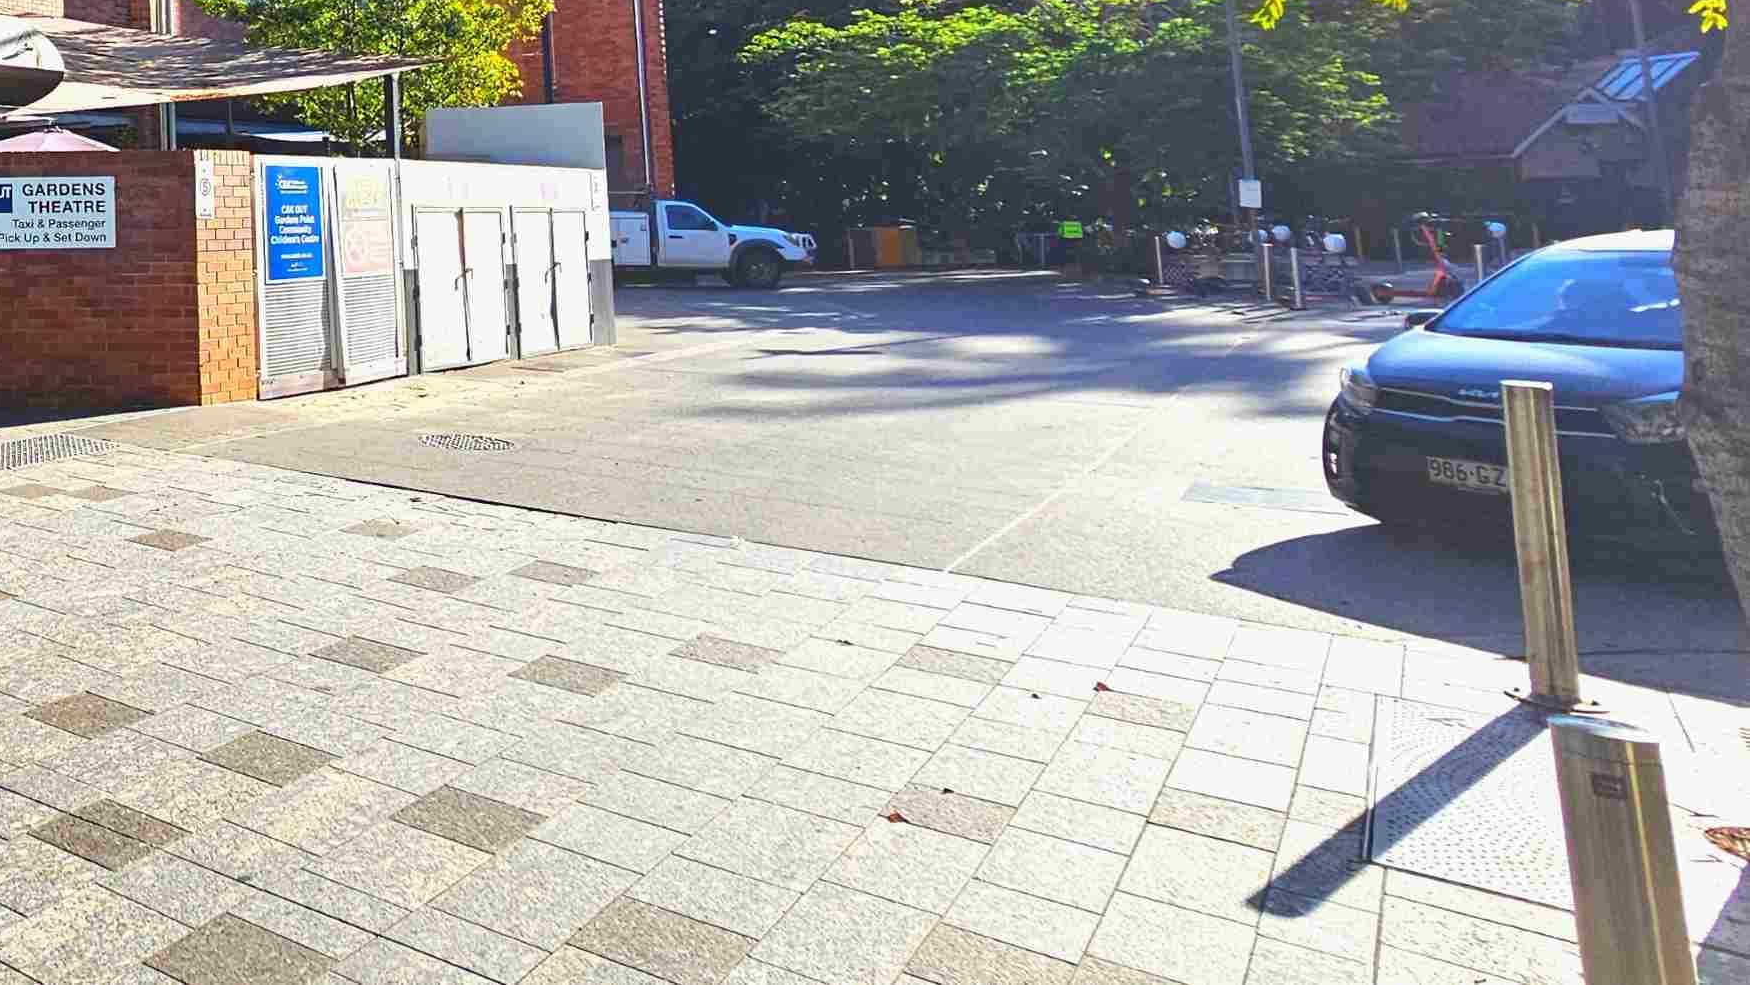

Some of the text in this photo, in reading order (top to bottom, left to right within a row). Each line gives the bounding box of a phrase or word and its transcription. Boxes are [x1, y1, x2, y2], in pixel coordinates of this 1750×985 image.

[22, 183, 106, 197] GARDENS
[28, 200, 107, 214] THEATRE
[12, 219, 107, 231] Taxi & Passenger
[24, 233, 40, 244] Up
[43, 233, 51, 242] &
[54, 233, 72, 243] Set
[75, 233, 107, 243] Down
